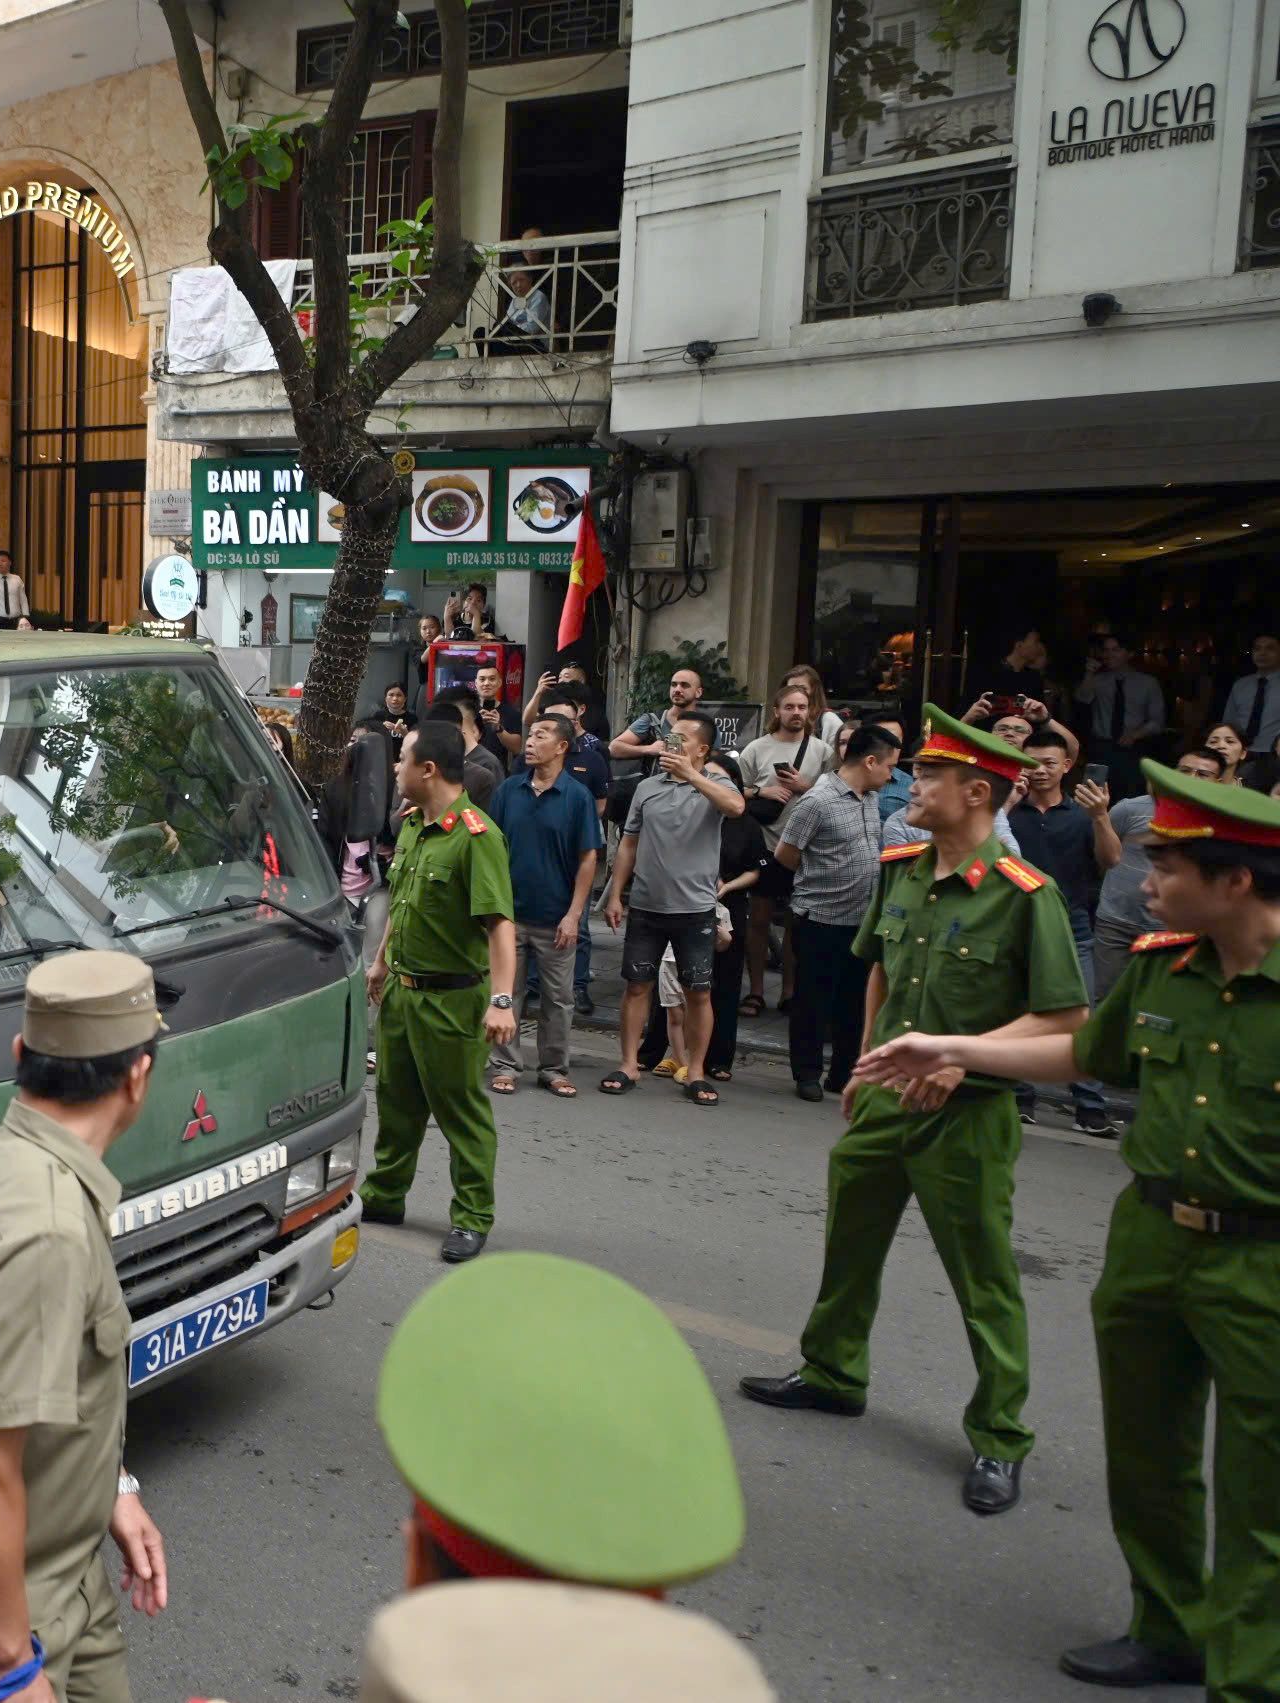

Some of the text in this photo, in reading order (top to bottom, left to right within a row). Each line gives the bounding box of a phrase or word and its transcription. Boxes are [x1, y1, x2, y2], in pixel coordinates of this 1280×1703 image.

[1050, 82, 1217, 145] LA NUEVA
[1048, 123, 1216, 167] BOUTIQUE HOTEL HANOI
[24, 181, 136, 279] PREMIUM
[273, 463, 304, 493] MỲ
[203, 496, 310, 545] BÀ DẦN
[462, 552, 480, 566] 024
[481, 552, 492, 565] 39
[493, 552, 505, 565] 35
[506, 552, 517, 565] 13
[518, 552, 530, 566] 43
[538, 552, 562, 566] 0933
[714, 717, 740, 732] PPY
[720, 731, 737, 746] UR
